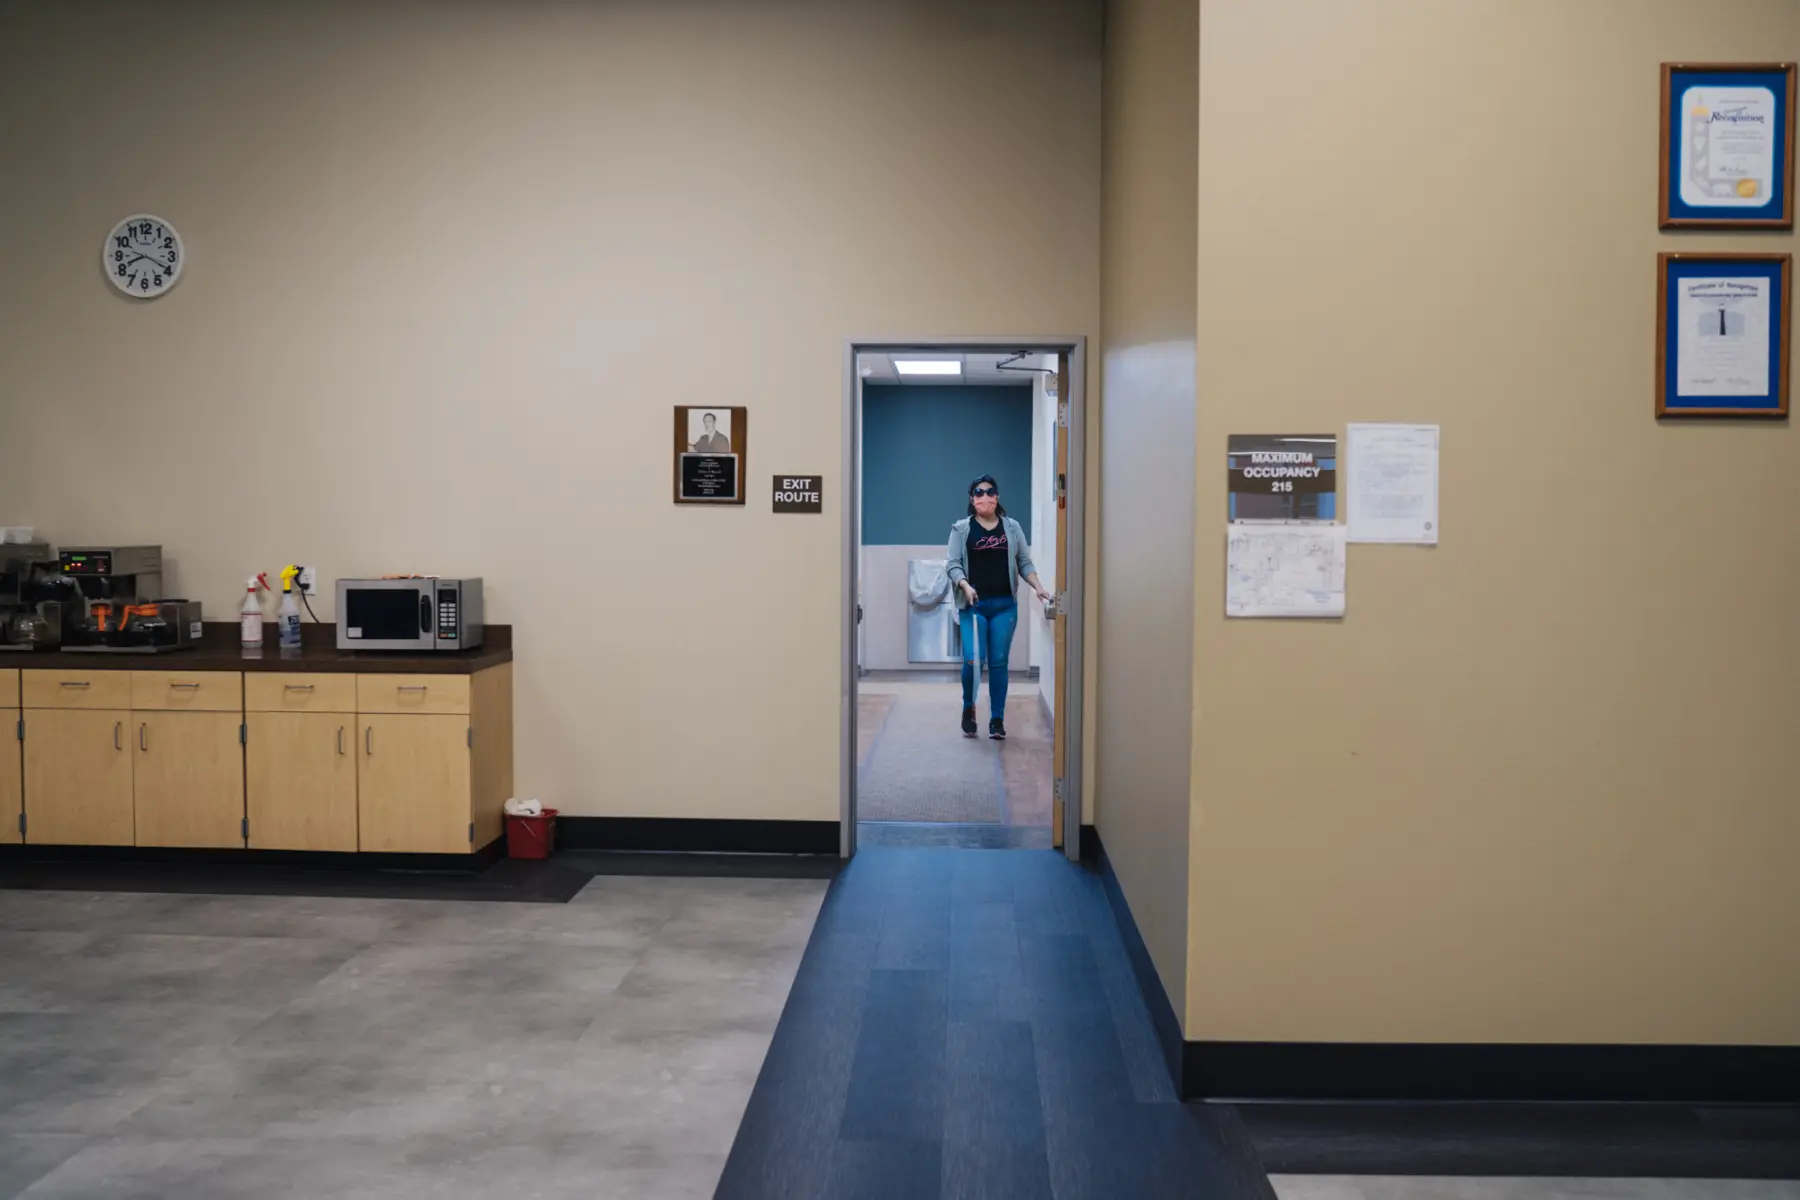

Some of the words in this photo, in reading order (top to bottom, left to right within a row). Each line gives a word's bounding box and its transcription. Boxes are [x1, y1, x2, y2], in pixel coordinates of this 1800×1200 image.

[128, 226, 137, 238] 11
[139, 223, 152, 235] 12
[156, 227, 162, 239] 1
[116, 236, 129, 248] 10
[163, 237, 173, 249] 2
[115, 250, 123, 262] 9
[167, 250, 176, 263] 3
[118, 263, 127, 277] 8
[163, 265, 173, 277] 4
[127, 274, 137, 286] 7
[140, 278, 149, 290] 6
[153, 275, 162, 286] 5
[1251, 453, 1313, 463] MAXIMUM
[1243, 467, 1321, 478] OCCUPANCY
[783, 479, 812, 490] EXIT
[1271, 481, 1293, 492] 215
[775, 491, 819, 503] ROUTE
